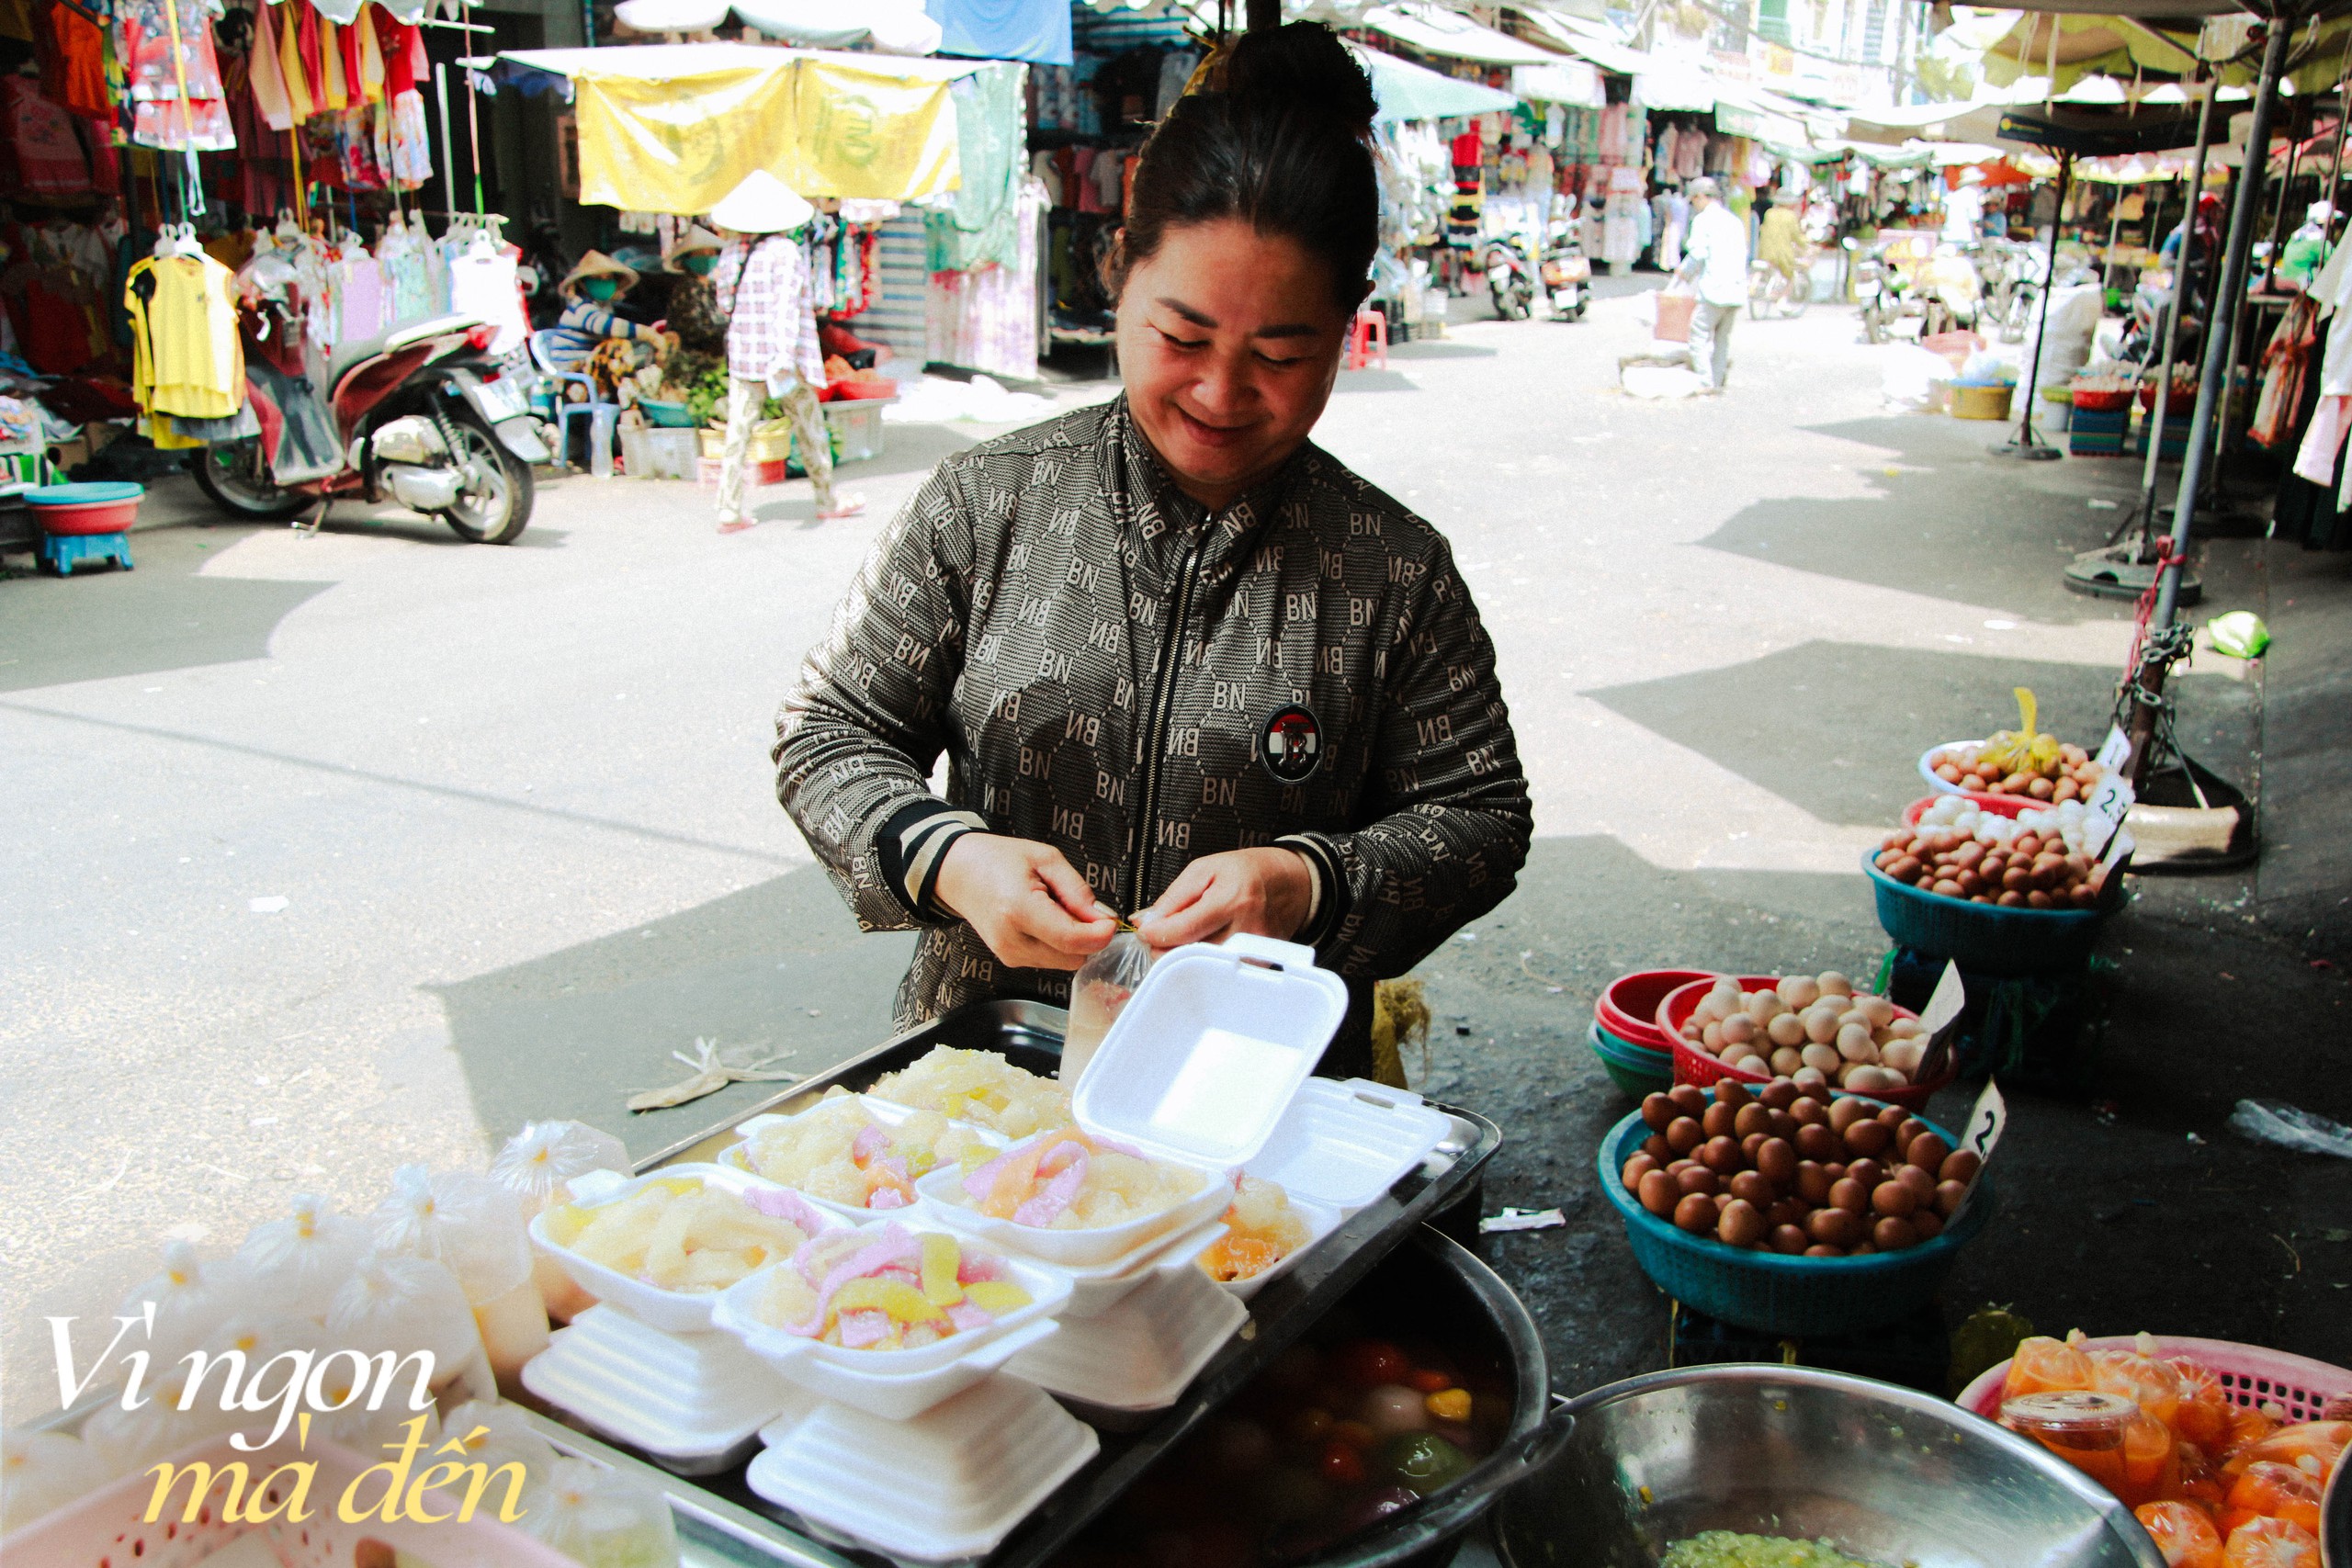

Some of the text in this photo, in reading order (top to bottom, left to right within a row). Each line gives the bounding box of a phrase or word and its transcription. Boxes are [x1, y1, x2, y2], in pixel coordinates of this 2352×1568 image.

[1031, 460, 1063, 486] BN
[925, 494, 955, 532] BN
[1136, 502, 1167, 541] BN
[1222, 502, 1257, 539] BN
[1351, 513, 1381, 536] BN
[1006, 543, 1033, 571] BN
[888, 570, 918, 609] BN
[1067, 557, 1100, 593] BN
[1129, 592, 1158, 626] BN
[1286, 592, 1317, 621] BN
[974, 634, 1002, 663] BN
[844, 653, 876, 690] BN
[1038, 648, 1073, 684] BN
[1447, 663, 1476, 692] BN
[1213, 681, 1246, 711] BN
[1019, 747, 1051, 780] BN
[1465, 745, 1501, 775] BN
[1096, 771, 1125, 806] BN
[1203, 776, 1238, 807] BN
[852, 856, 873, 890] BN
[1086, 862, 1116, 893] BN
